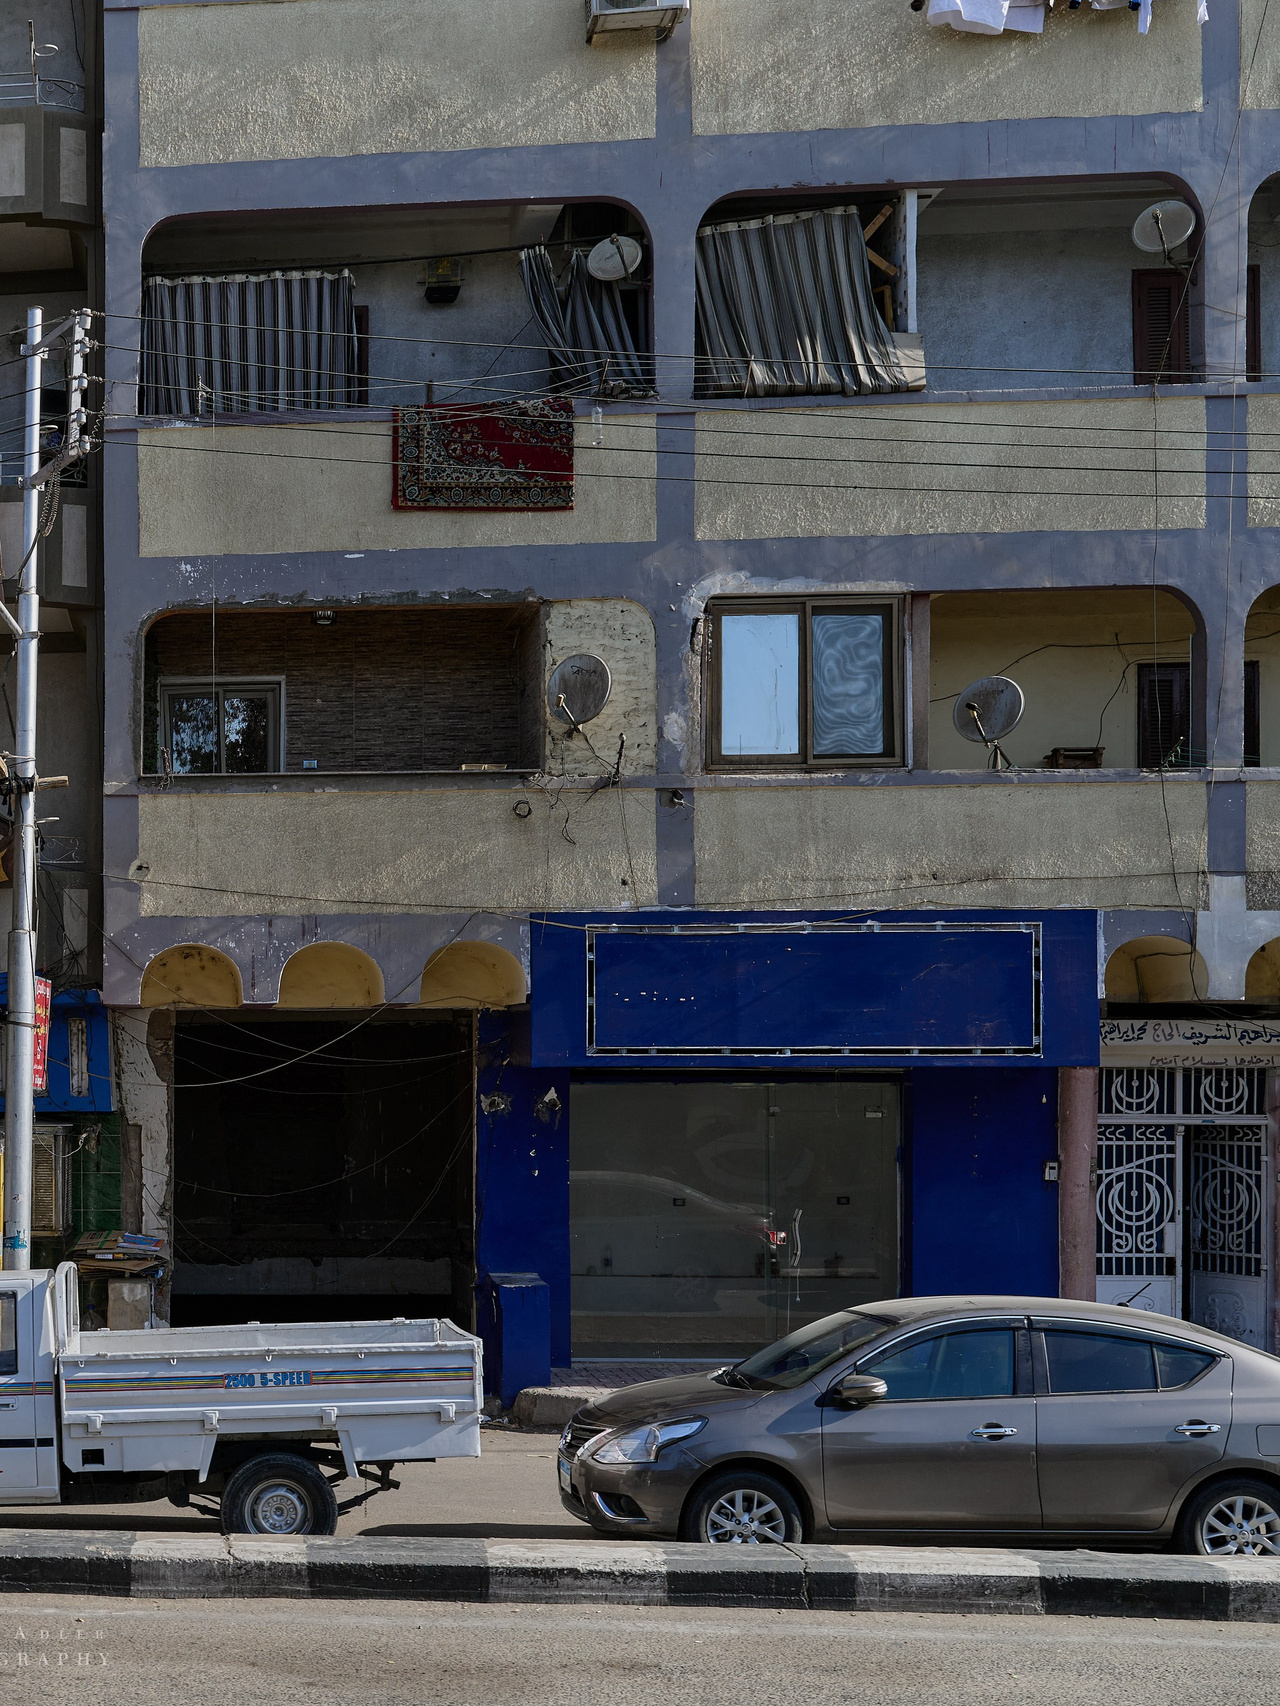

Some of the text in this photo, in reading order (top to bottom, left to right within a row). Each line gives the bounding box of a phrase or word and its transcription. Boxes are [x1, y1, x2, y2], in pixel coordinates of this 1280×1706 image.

[1153, 1021, 1181, 1042] الحاج
[1182, 1022, 1238, 1046] الشريف
[1182, 1056, 1228, 1067] بسلام
[224, 1371, 311, 1388] 2500 5-SPEED
